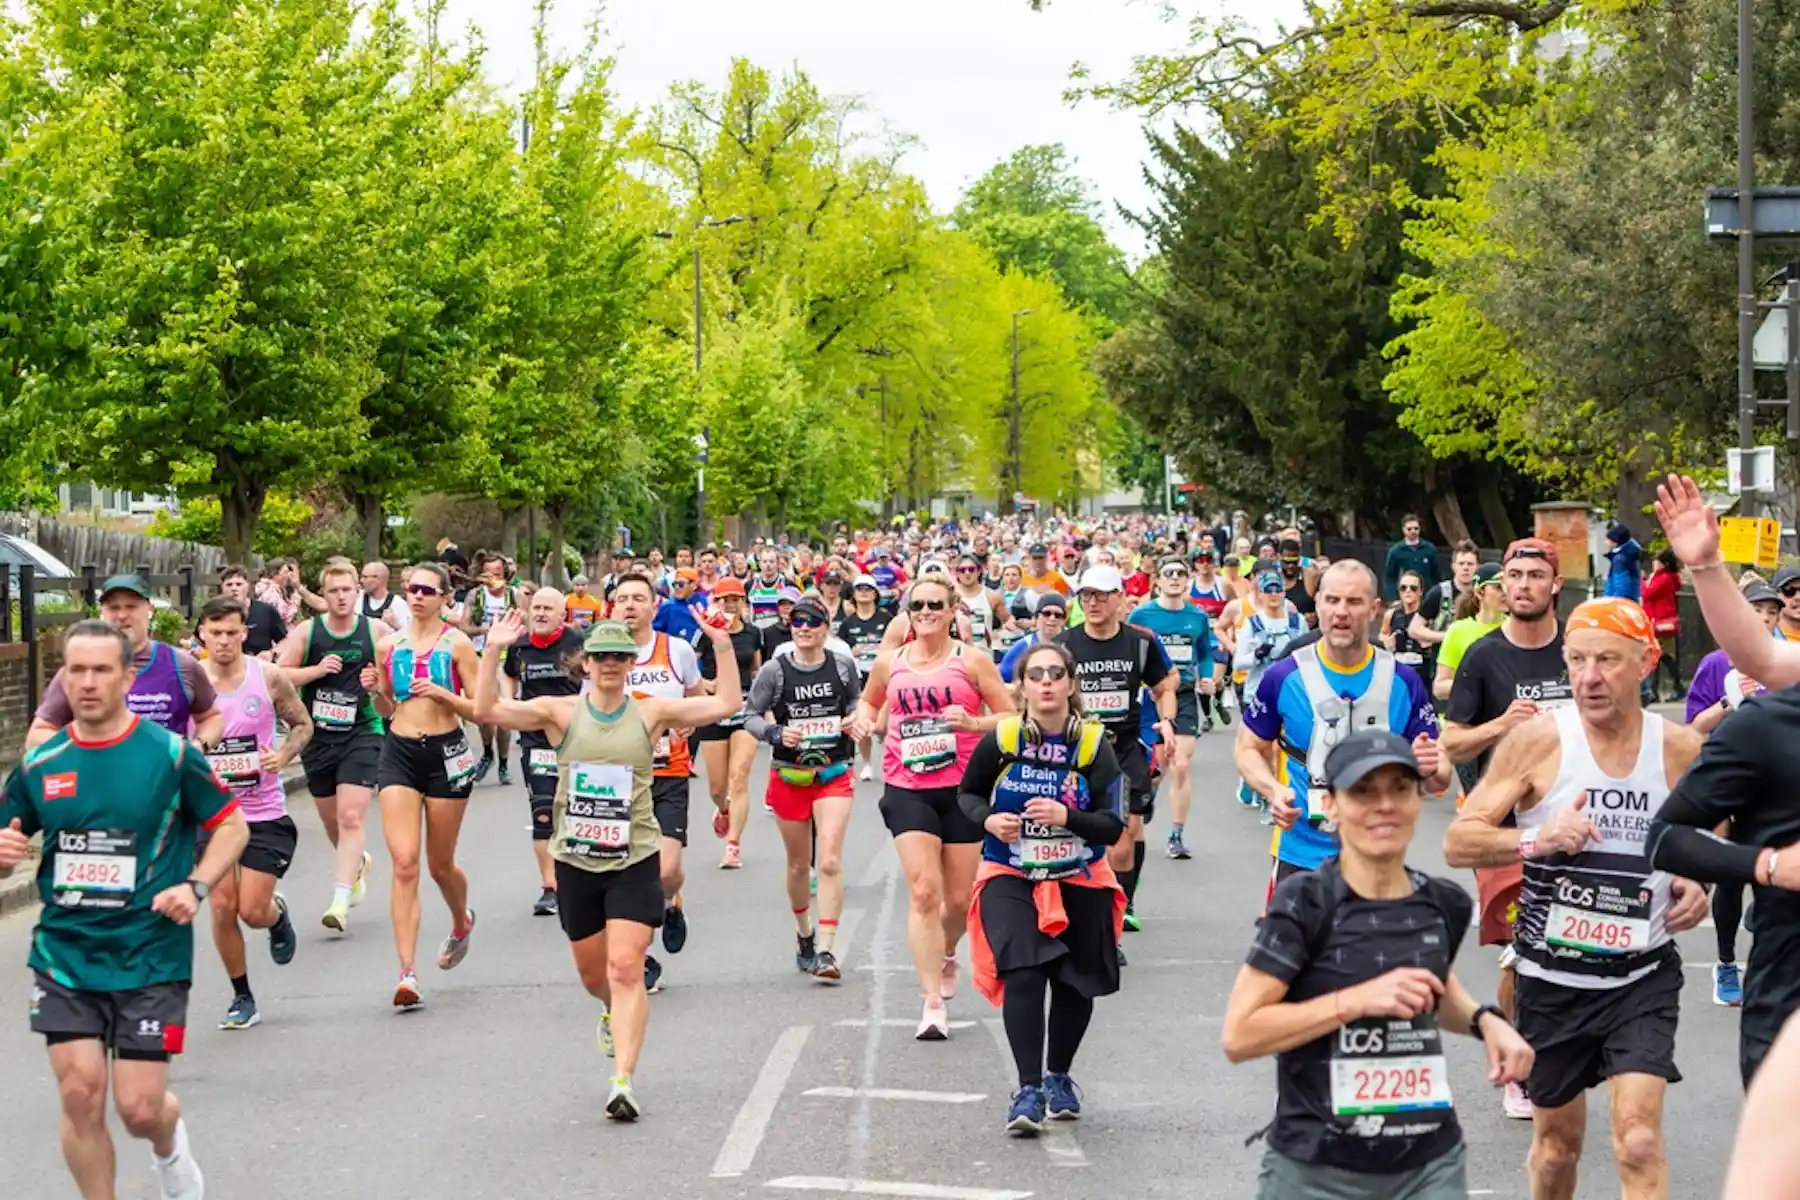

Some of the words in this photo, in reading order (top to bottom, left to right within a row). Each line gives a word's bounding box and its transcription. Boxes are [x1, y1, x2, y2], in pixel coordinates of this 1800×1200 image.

[1075, 661, 1134, 675] ANDREW
[794, 682, 833, 700] INGE
[1021, 765, 1058, 781] Brain
[1586, 789, 1649, 811] TOM
[575, 822, 620, 841] 22915
[1033, 842, 1074, 861] 19457
[65, 863, 121, 884] 24892
[1562, 915, 1632, 948] 20495
[1354, 1068, 1433, 1100] 22295
